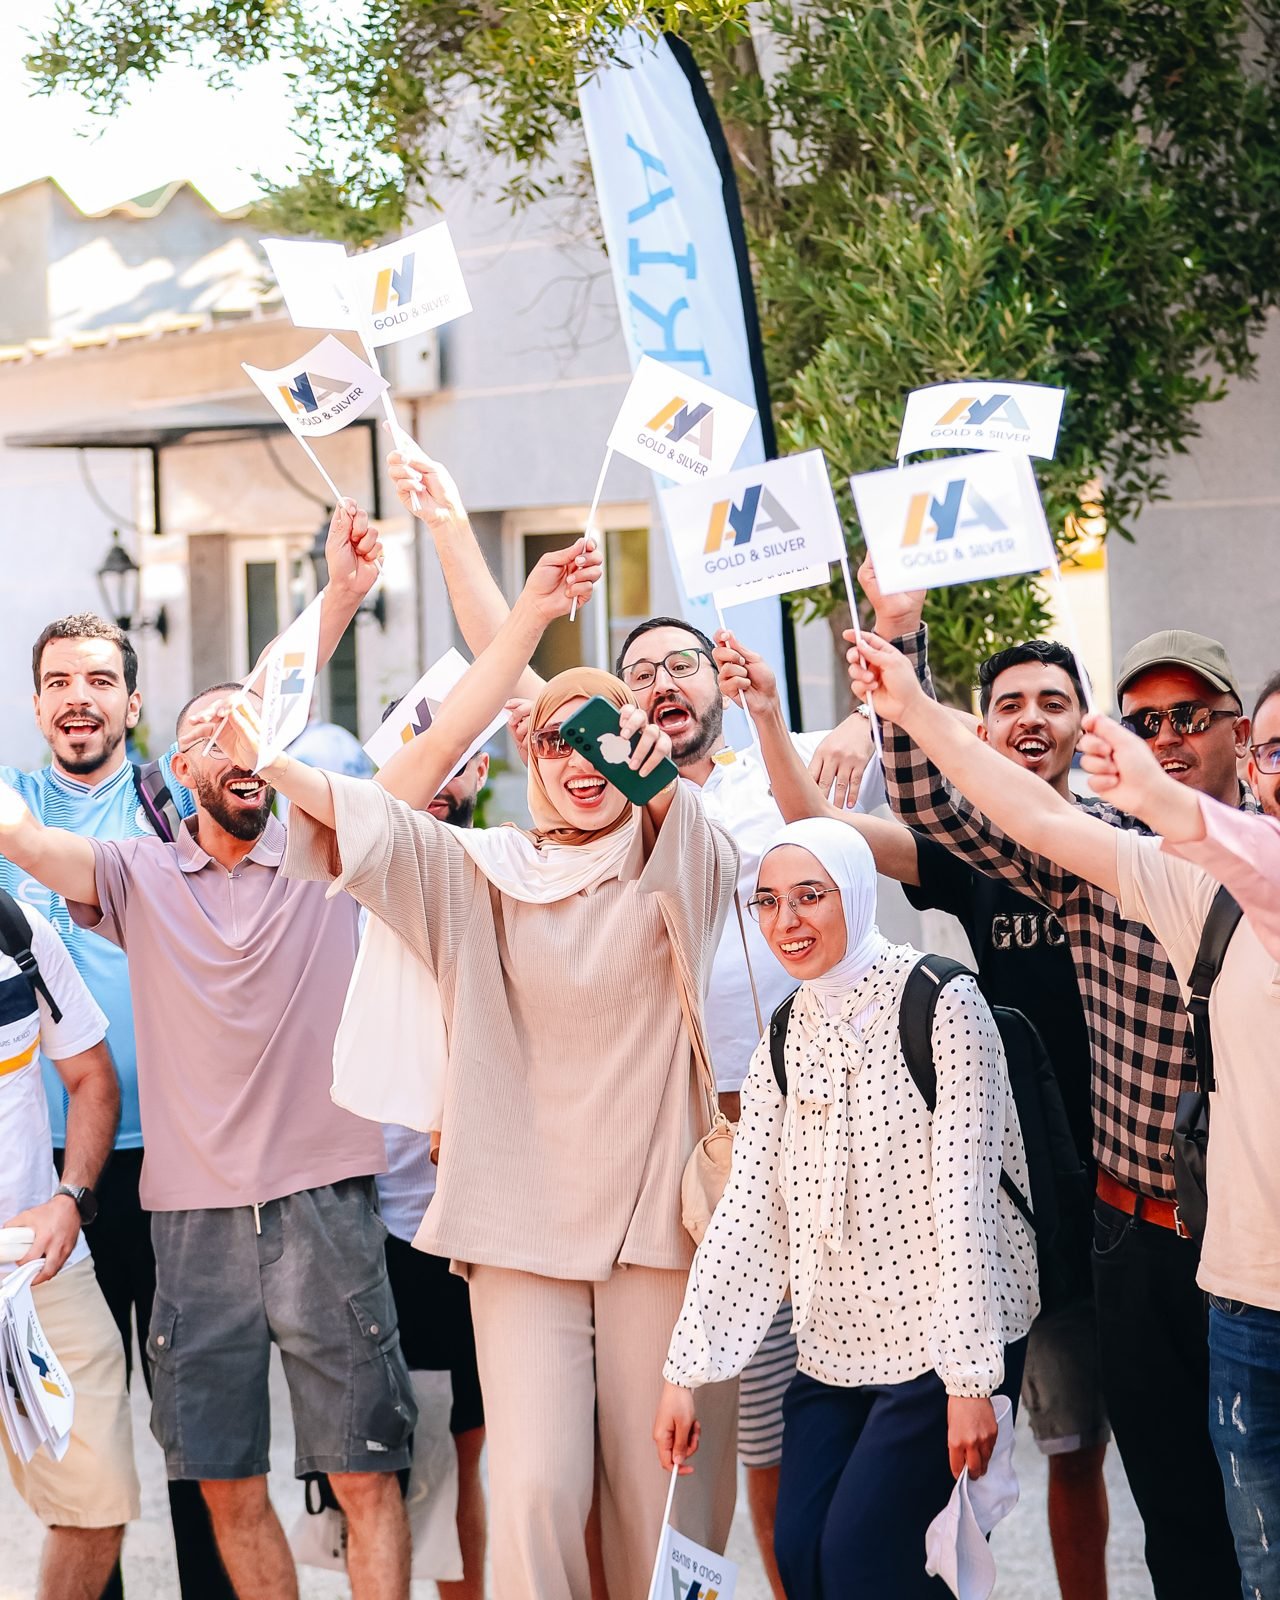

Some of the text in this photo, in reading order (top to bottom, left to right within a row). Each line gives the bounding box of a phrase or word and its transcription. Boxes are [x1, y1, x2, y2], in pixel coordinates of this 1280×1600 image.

[374, 294, 451, 331] GOLD & SILVER
[296, 387, 364, 427] GOLD & SILVER
[930, 428, 1032, 443] GOLD & SILVER
[637, 433, 709, 477] GOLD & SILVER
[704, 537, 806, 574] GOLD & SILVER
[901, 537, 1016, 567] GOLD & SILVER
[699, 1564, 722, 1585] GOLD
